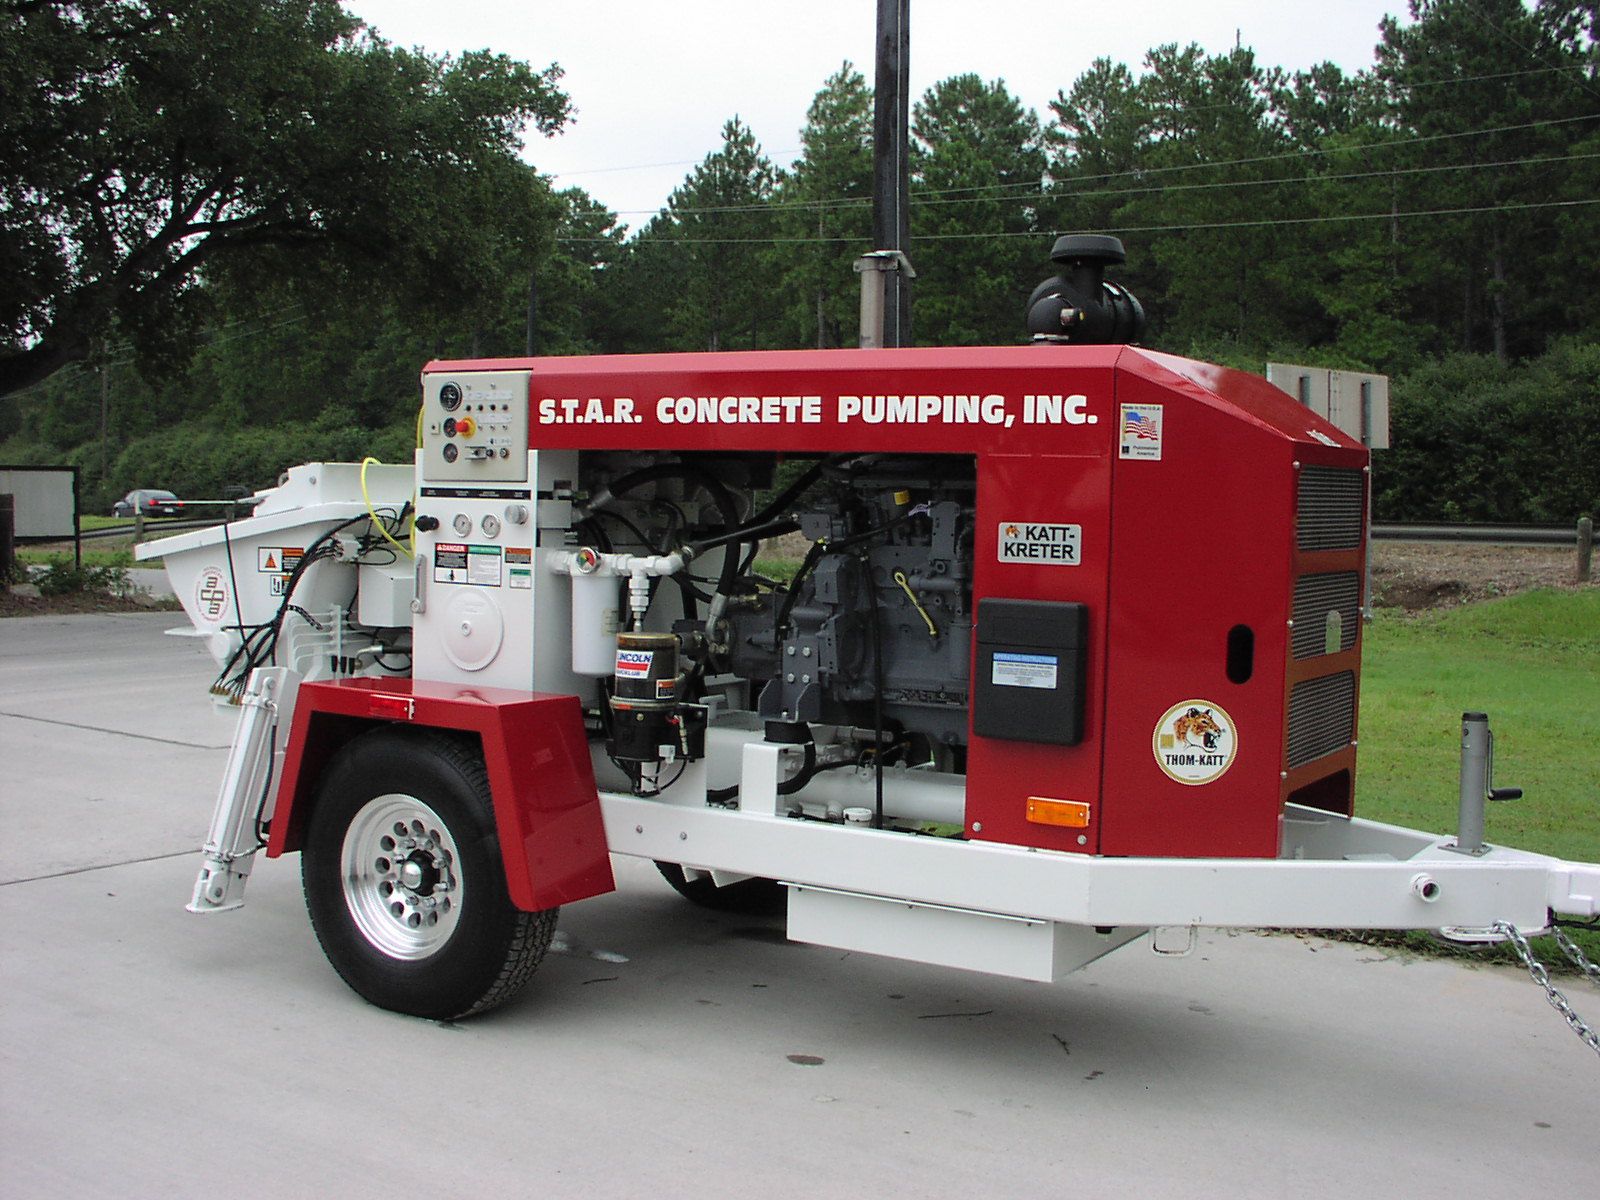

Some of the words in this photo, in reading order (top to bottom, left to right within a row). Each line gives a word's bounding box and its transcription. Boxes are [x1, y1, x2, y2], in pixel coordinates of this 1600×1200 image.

[540, 398, 643, 424] S.T.A.R.
[656, 396, 822, 424] CONCRETE
[837, 395, 1016, 428] PUMPING,
[1023, 394, 1098, 424] INC.
[1025, 525, 1075, 542] KATT-
[1004, 542, 1074, 560] KRETER
[1165, 754, 1224, 766] THOM-KATT
